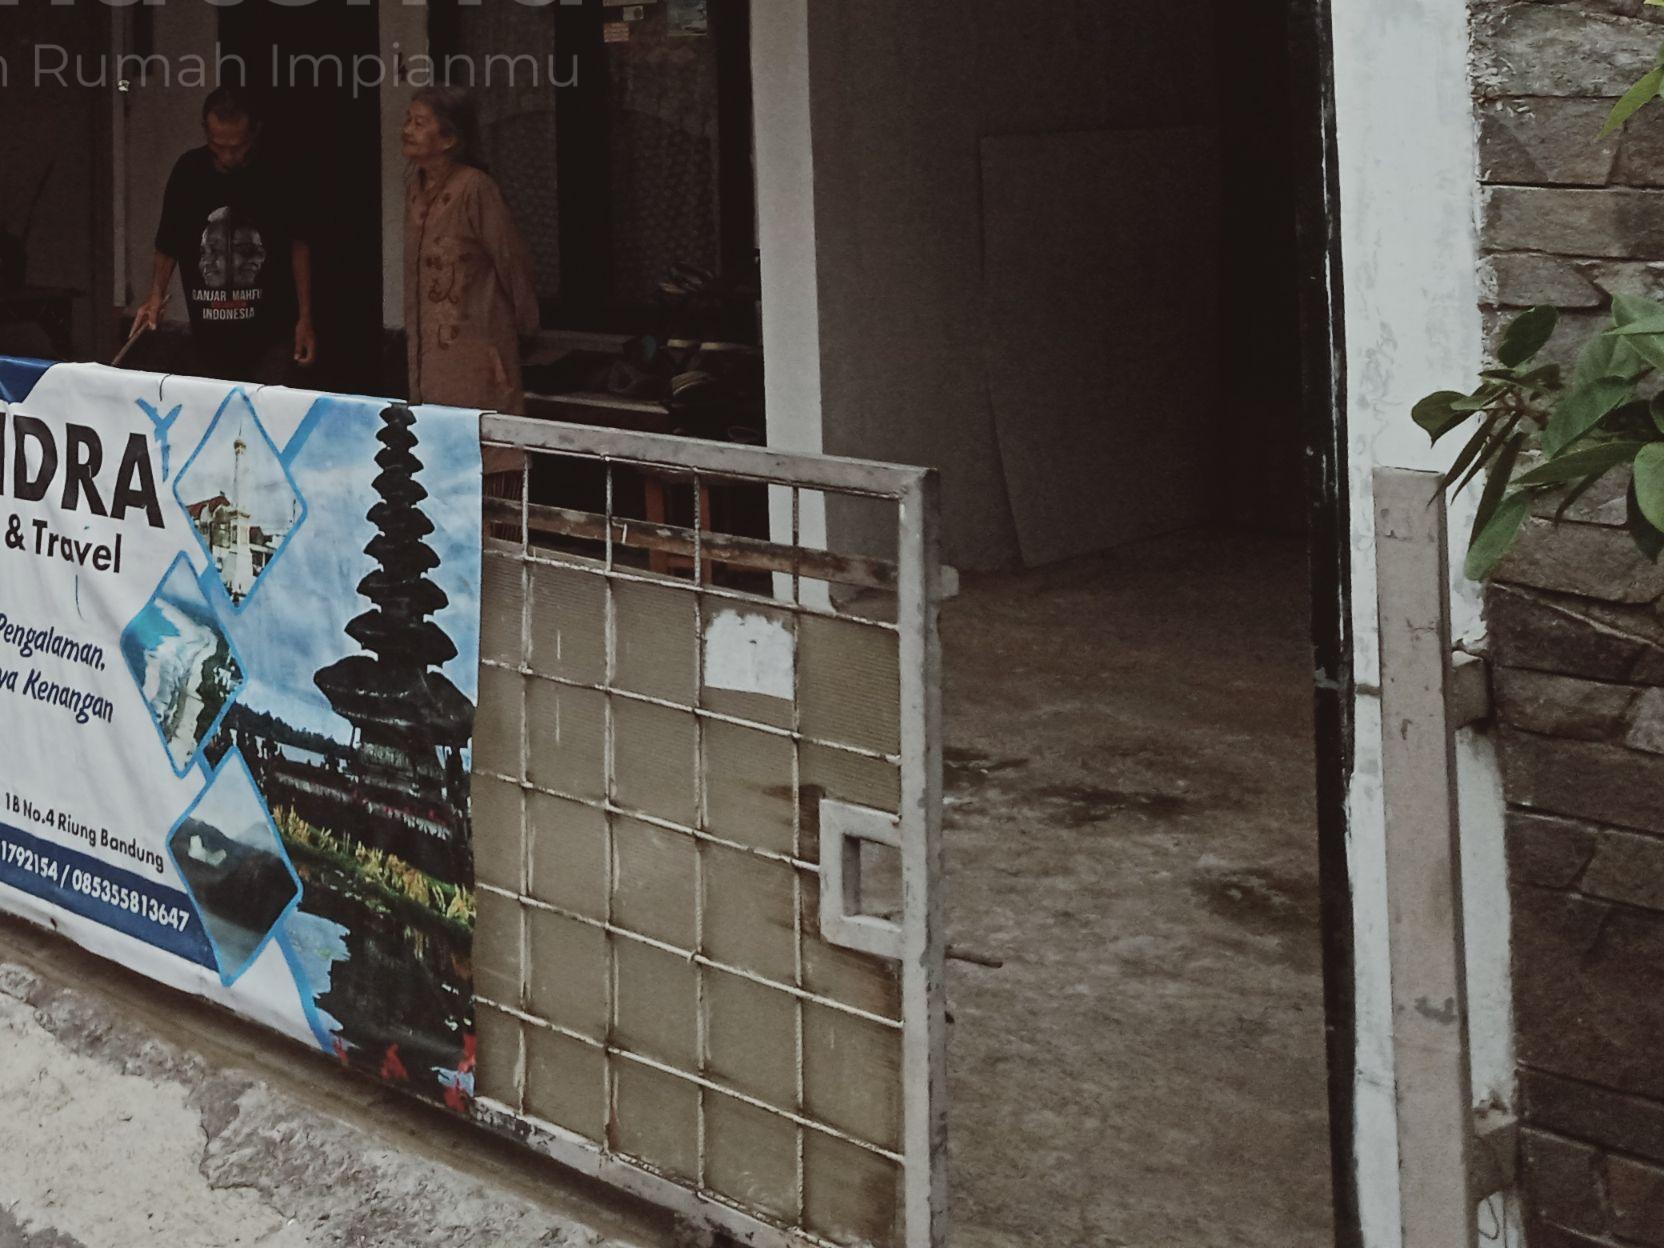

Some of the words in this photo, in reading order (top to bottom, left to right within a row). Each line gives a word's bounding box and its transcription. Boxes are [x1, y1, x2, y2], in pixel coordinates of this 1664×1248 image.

[202, 306, 255, 320] INDONESIA
[4, 513, 26, 551] &
[32, 518, 122, 574] Travel
[22, 668, 113, 724] Kenangan
[5, 792, 20, 813] 1B
[58, 813, 97, 847] Riung
[100, 829, 164, 874] Bandung
[71, 870, 190, 932] 085355813647
